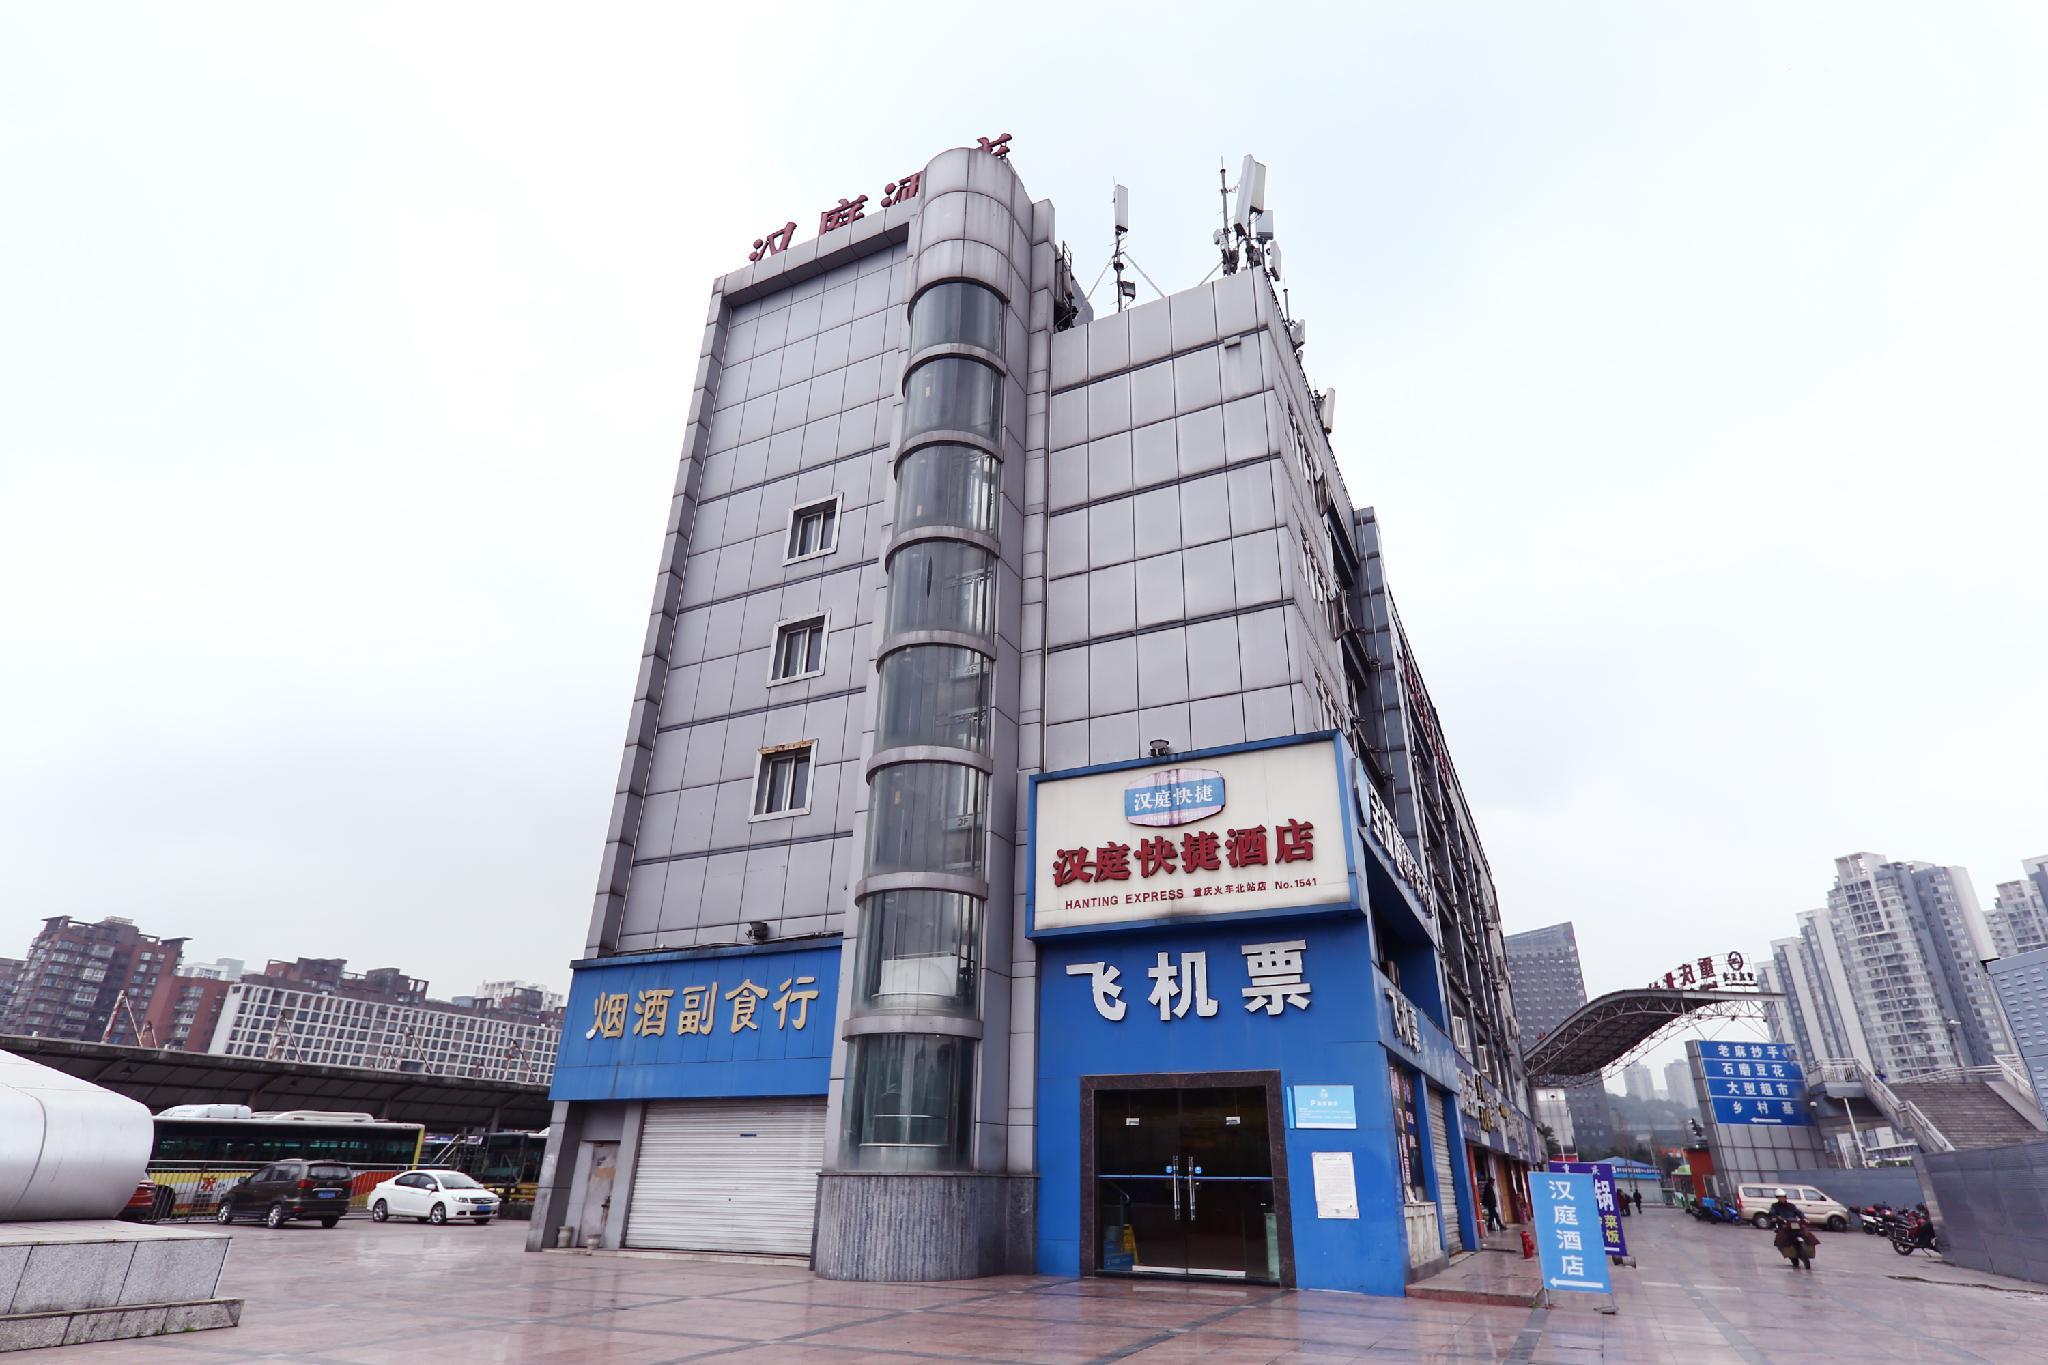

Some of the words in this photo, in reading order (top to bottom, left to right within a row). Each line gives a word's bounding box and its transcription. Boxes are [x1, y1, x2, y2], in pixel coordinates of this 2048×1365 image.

[1134, 784, 1213, 812] 汉庭快捷
[1052, 818, 1314, 888] 汉庭快捷酒店
[1065, 896, 1119, 910] HANTING
[1125, 888, 1184, 905] EXPRESS
[1193, 881, 1267, 898] 重庆火车北站店
[1274, 877, 1317, 890] No.1541
[1066, 940, 1312, 1022] 飞机票
[586, 976, 820, 1040] 烟酒副食行
[1721, 1062, 1785, 1077] 石磨豆花
[1726, 1081, 1789, 1096] 大型超市
[1548, 1180, 1585, 1277] 汉庭酒店
